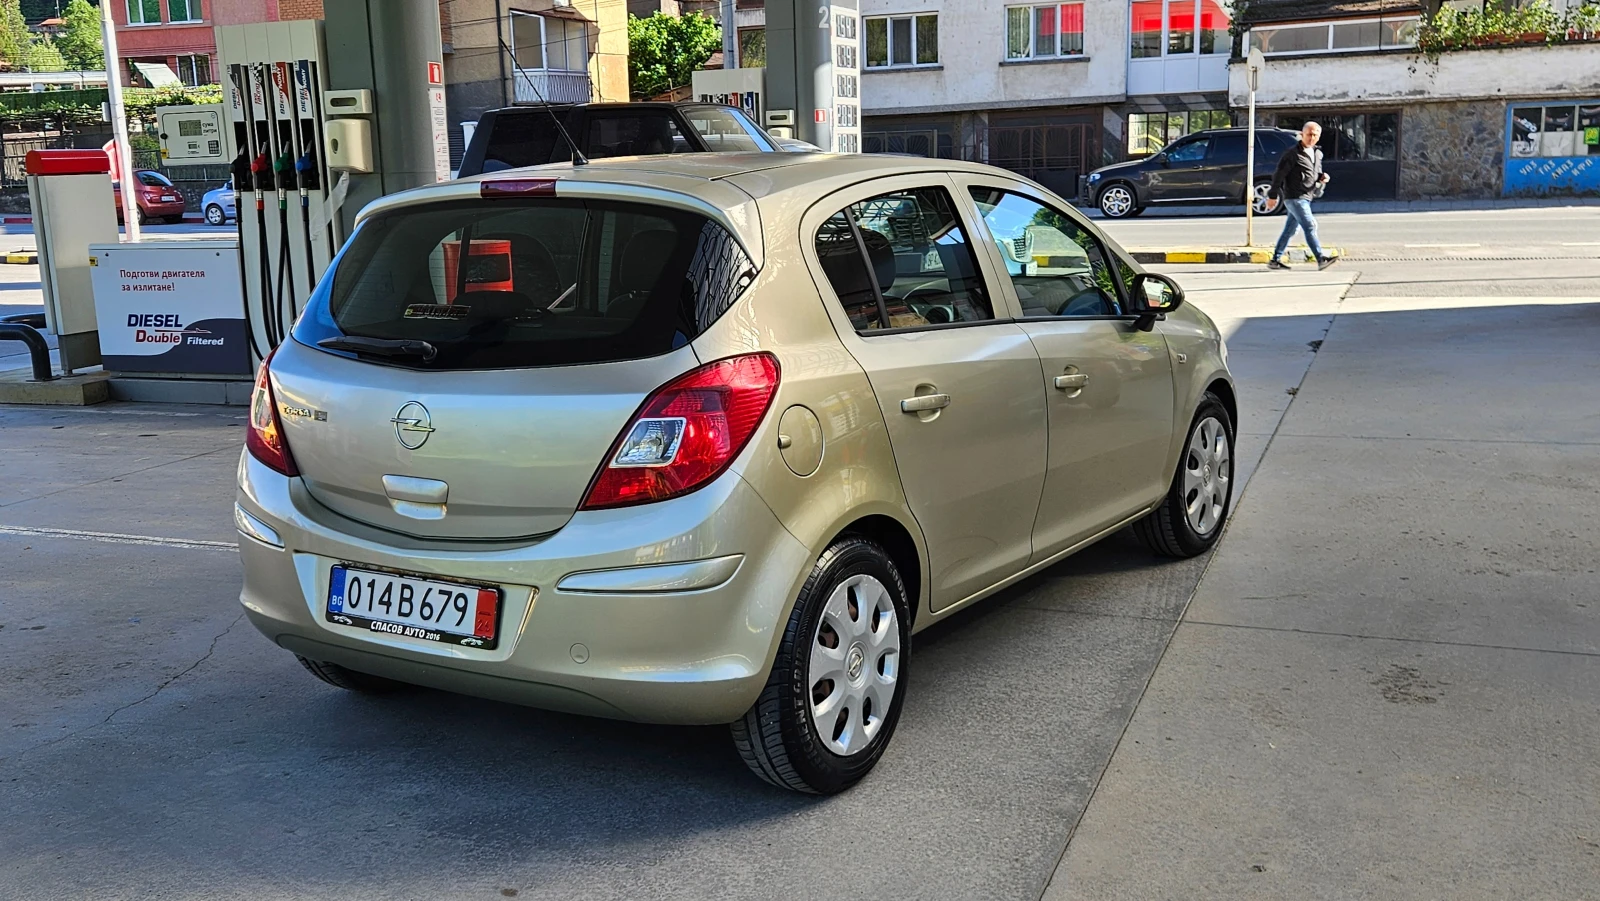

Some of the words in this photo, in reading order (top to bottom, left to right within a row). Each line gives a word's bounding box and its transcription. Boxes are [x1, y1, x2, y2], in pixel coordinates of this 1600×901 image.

[818, 6, 829, 28] 2
[120, 269, 160, 280] Подготви
[162, 269, 205, 280] двигателя
[132, 282, 175, 292] излитане!
[127, 314, 183, 328] DIESEL
[135, 329, 181, 343] Double
[187, 336, 224, 346] Filtered
[331, 595, 343, 605] BG
[348, 576, 469, 627] 014B679
[370, 620, 403, 634] СПАСОВ
[403, 628, 425, 639] АУТО
[426, 632, 441, 641] 2016
